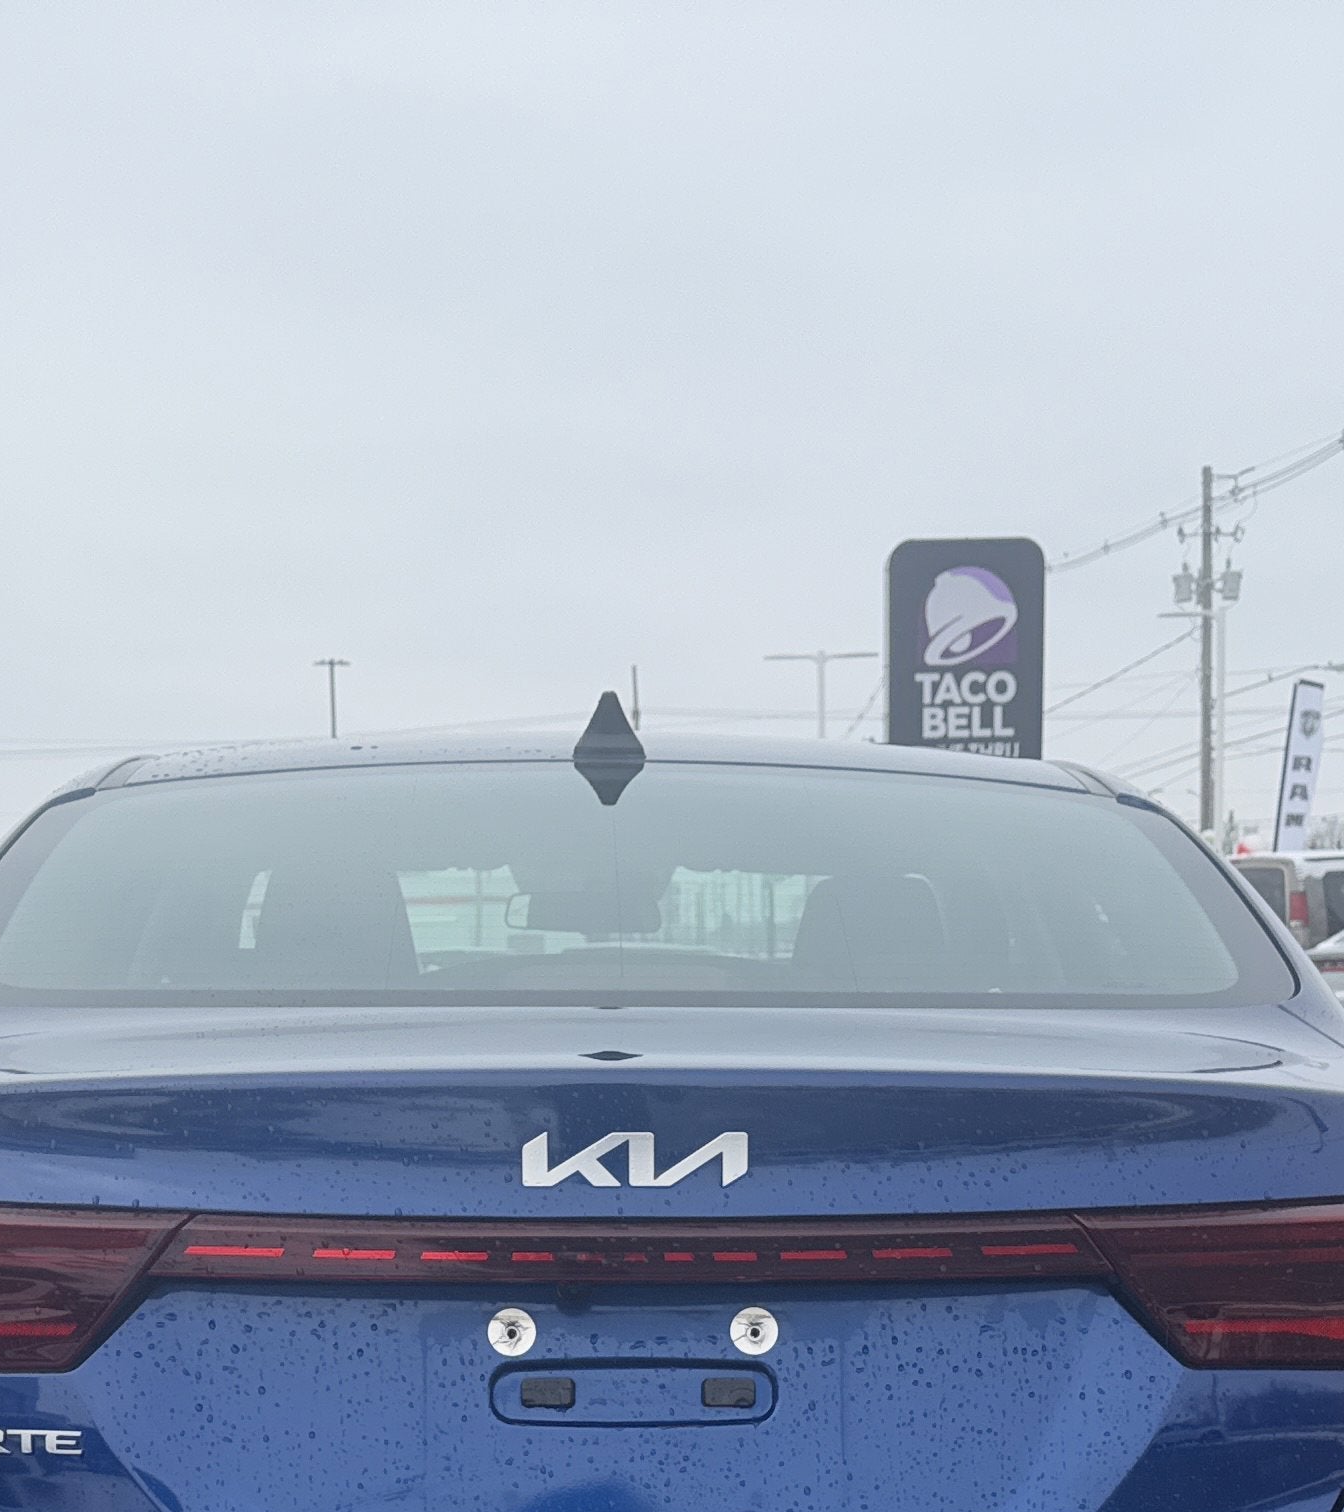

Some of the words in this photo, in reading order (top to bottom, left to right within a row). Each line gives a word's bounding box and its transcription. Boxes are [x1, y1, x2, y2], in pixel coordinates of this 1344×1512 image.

[914, 671, 1017, 705] TACO
[921, 705, 1015, 739] BELL
[1285, 755, 1313, 827] RAM
[522, 1131, 748, 1187] KIA
